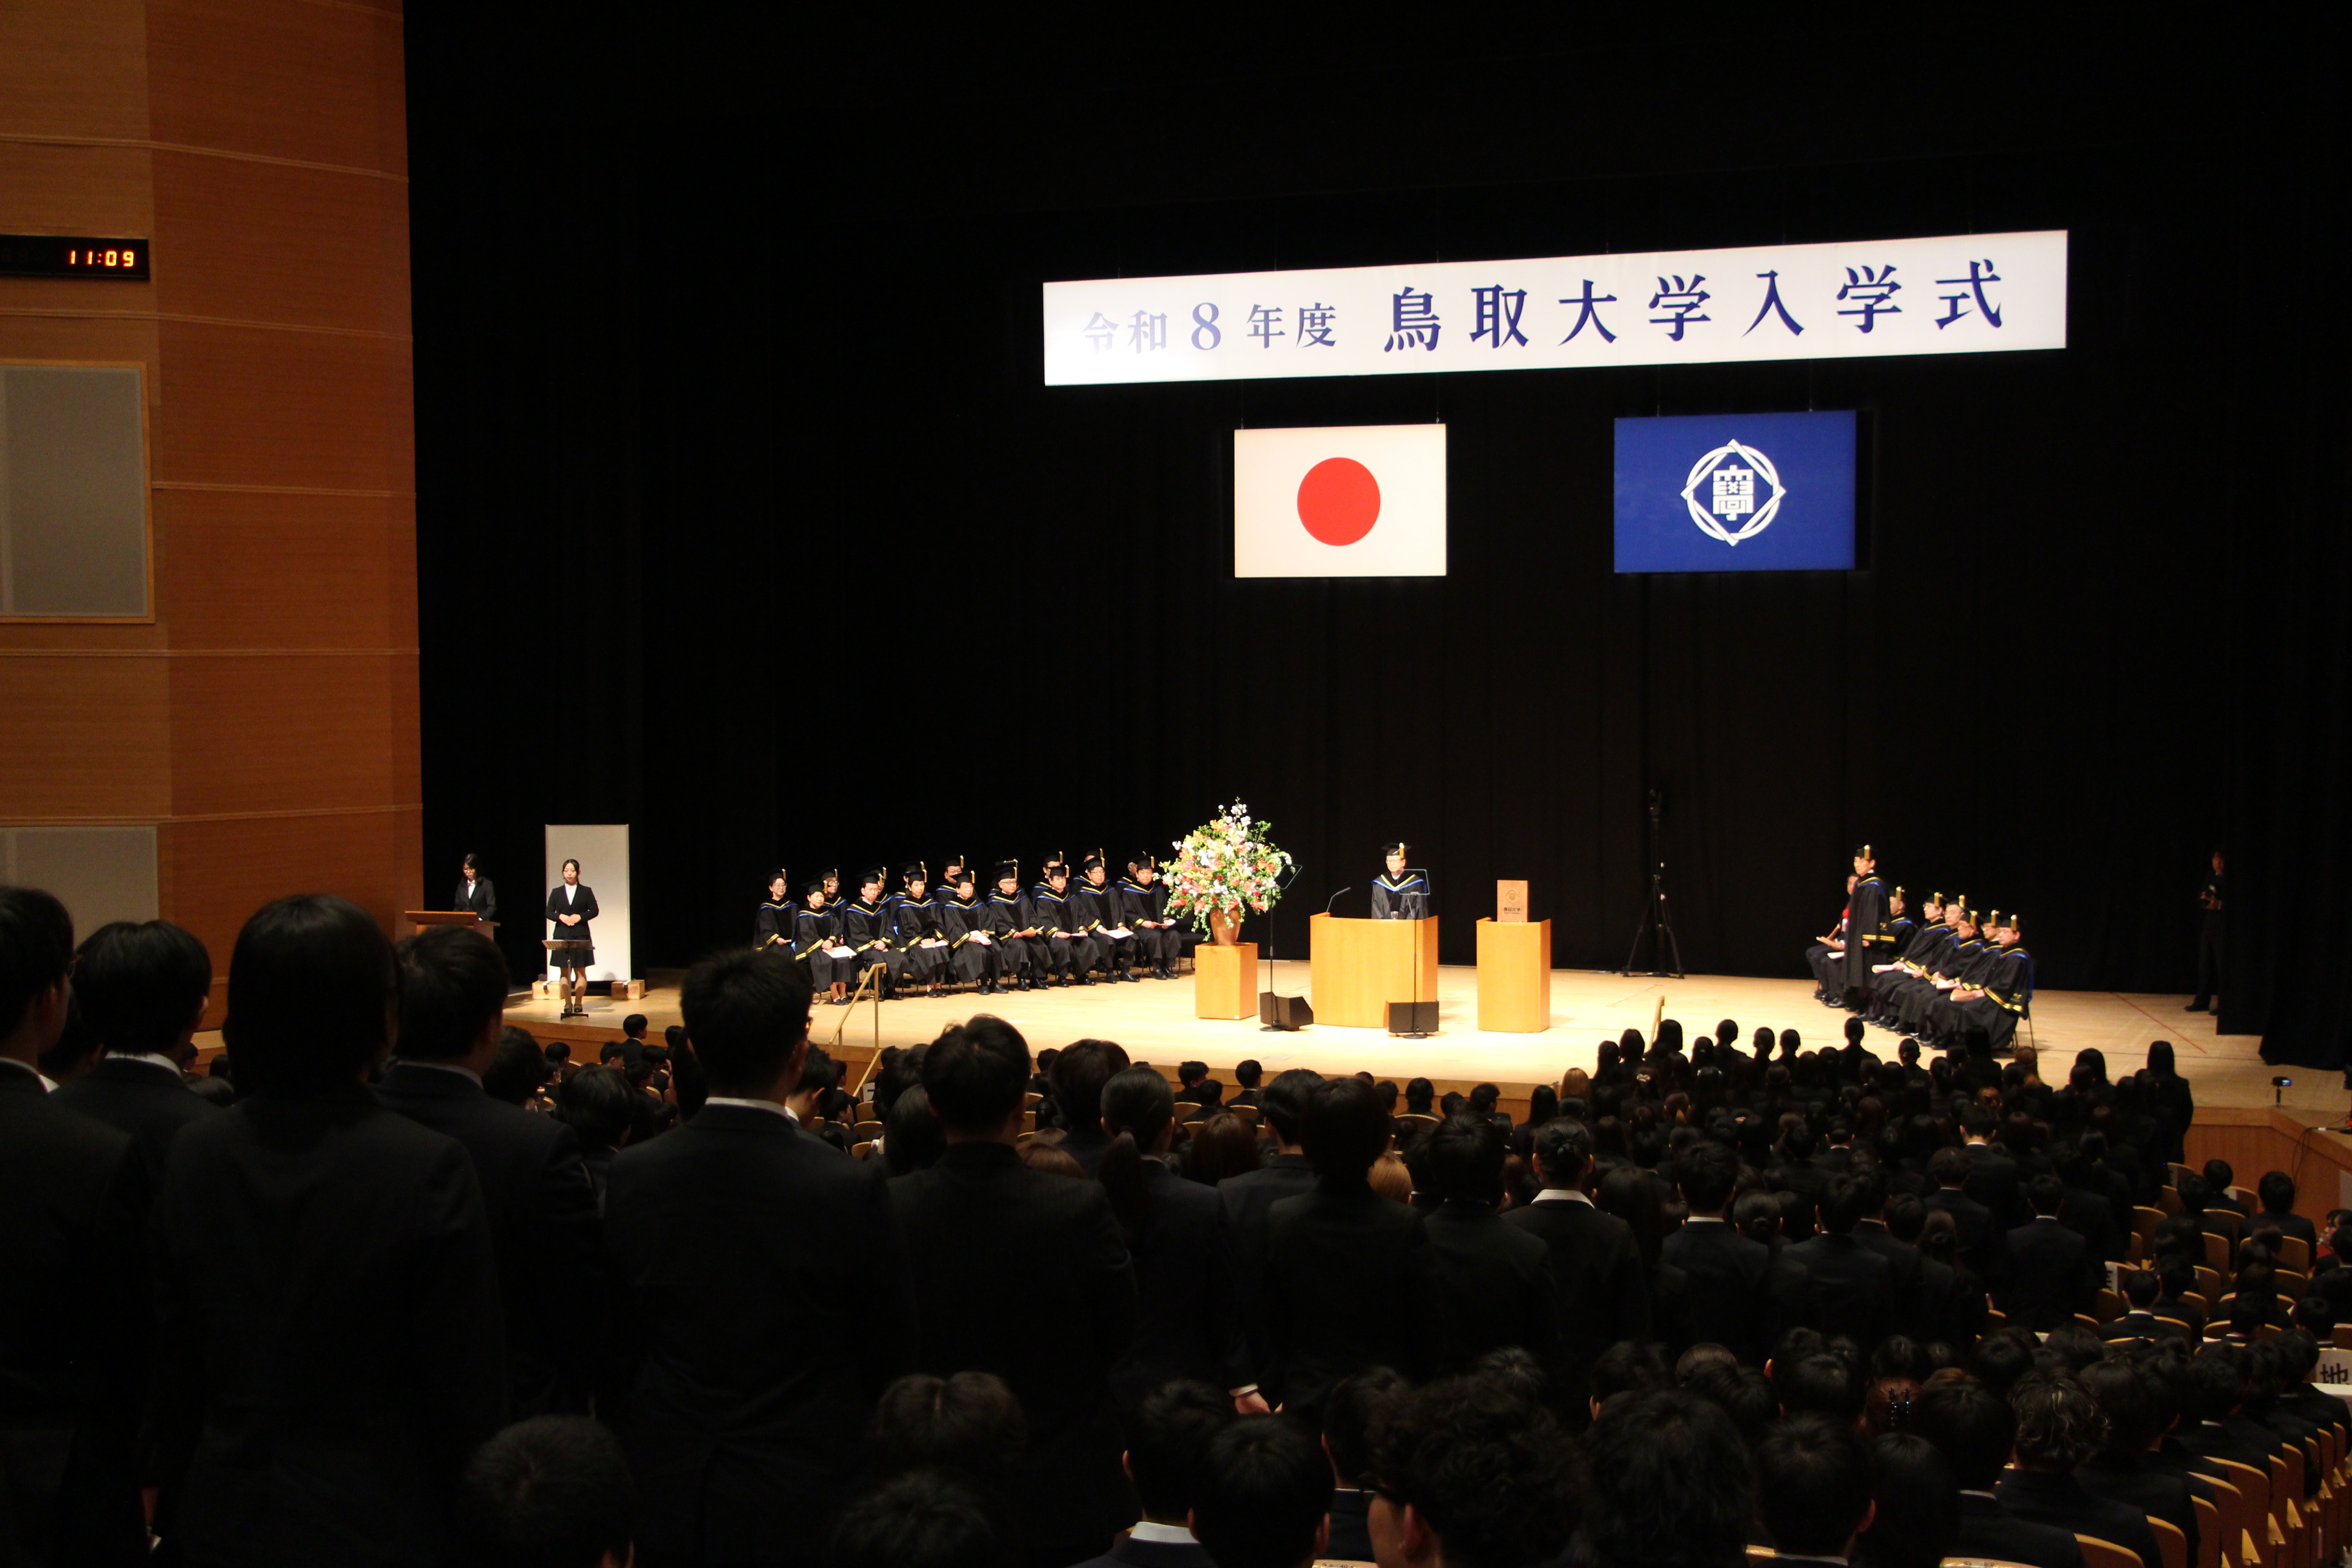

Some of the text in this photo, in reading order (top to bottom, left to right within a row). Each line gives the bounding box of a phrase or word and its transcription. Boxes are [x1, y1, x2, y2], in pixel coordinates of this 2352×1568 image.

[70, 250, 134, 267] 11:09
[1082, 258, 2003, 355] 令和8年度 鳥取大学入学式
